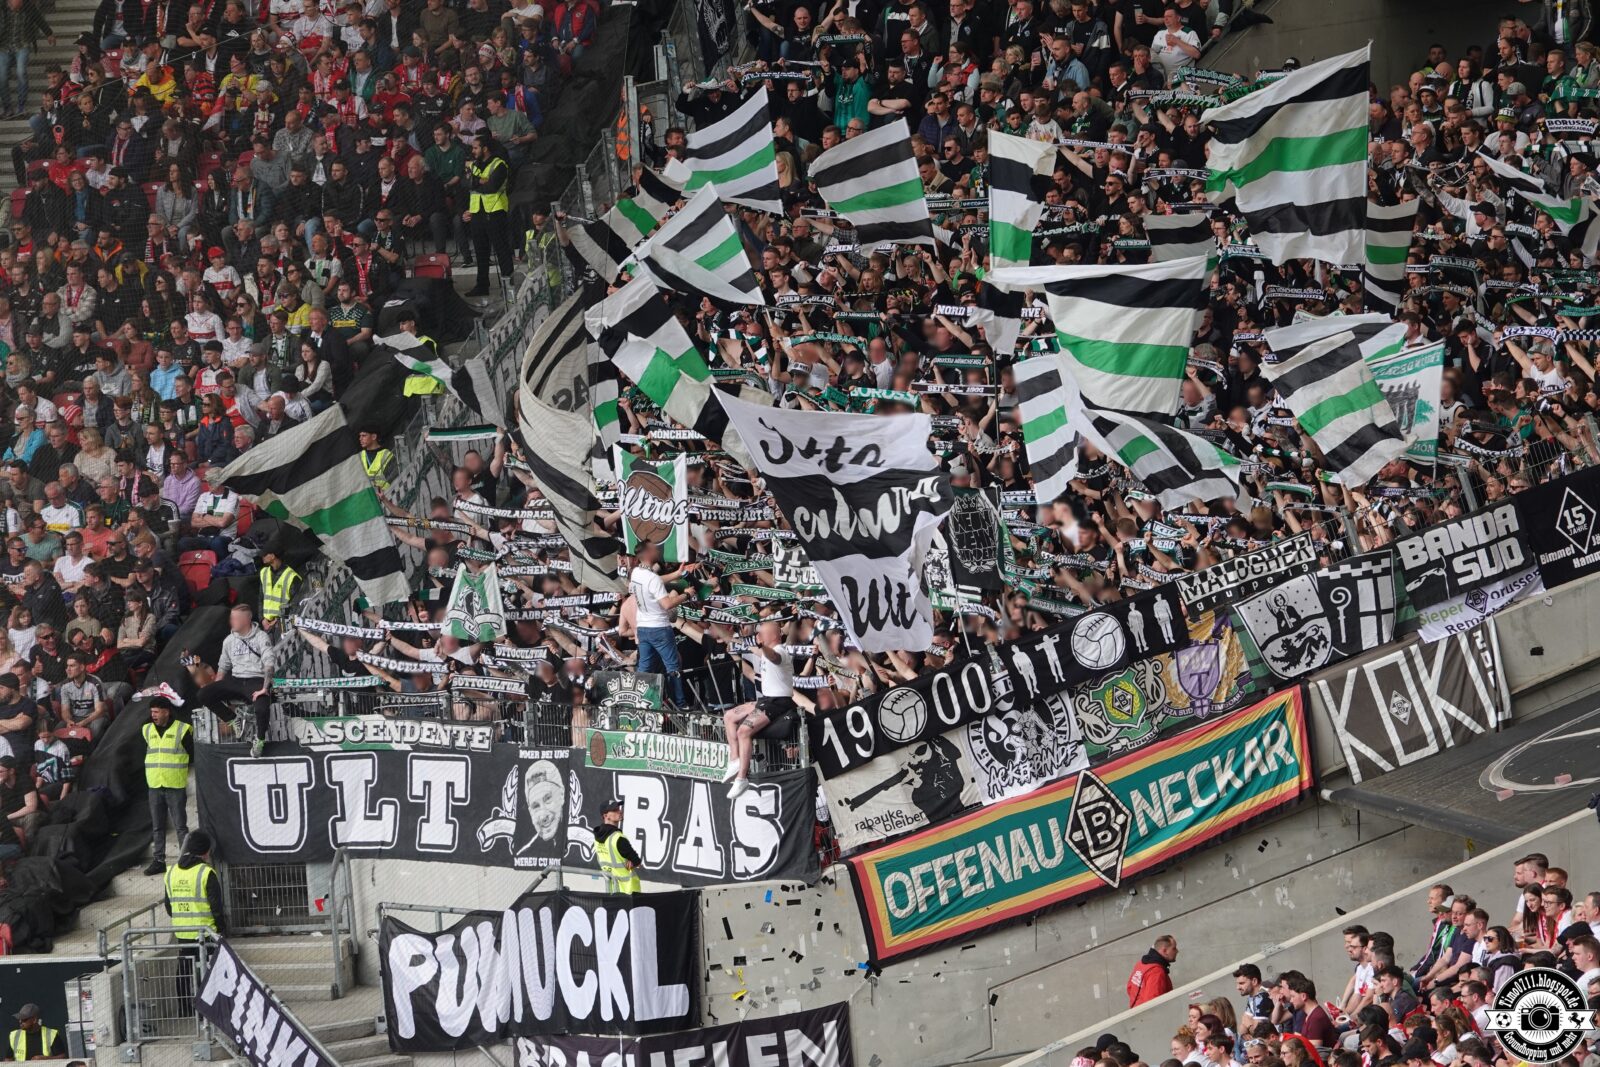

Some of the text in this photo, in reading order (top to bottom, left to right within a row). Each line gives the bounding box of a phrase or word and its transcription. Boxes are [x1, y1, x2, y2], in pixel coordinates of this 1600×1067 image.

[936, 304, 1042, 318] NORD RVE
[455, 499, 555, 519] MÖNCHENGLADBACH
[617, 479, 689, 526] Ultras
[699, 510, 764, 522] VITUSSTADT
[1563, 504, 1586, 530] 15
[1396, 503, 1520, 571] BANDA
[1568, 523, 1589, 536] JAHRE
[1452, 536, 1525, 586] SUD
[1540, 544, 1576, 566] Bimmel
[1181, 537, 1312, 602] MALOCHER
[543, 592, 620, 608] MÖNCHENGLDBACH
[294, 618, 384, 640] ASCENDENTE
[452, 677, 526, 694] SOTTOCULTURA
[618, 694, 638, 702] NORD
[299, 719, 495, 753] ASCENDENTE
[821, 705, 875, 770] 19
[540, 749, 554, 760] BEI
[554, 749, 570, 760] UNS
[987, 741, 1079, 800] ACKERBANDE
[1129, 719, 1296, 838] NECKAR
[854, 807, 903, 832] rabauke
[882, 817, 1065, 920] OFFENAU
[388, 905, 690, 1039] PUMUCKL
